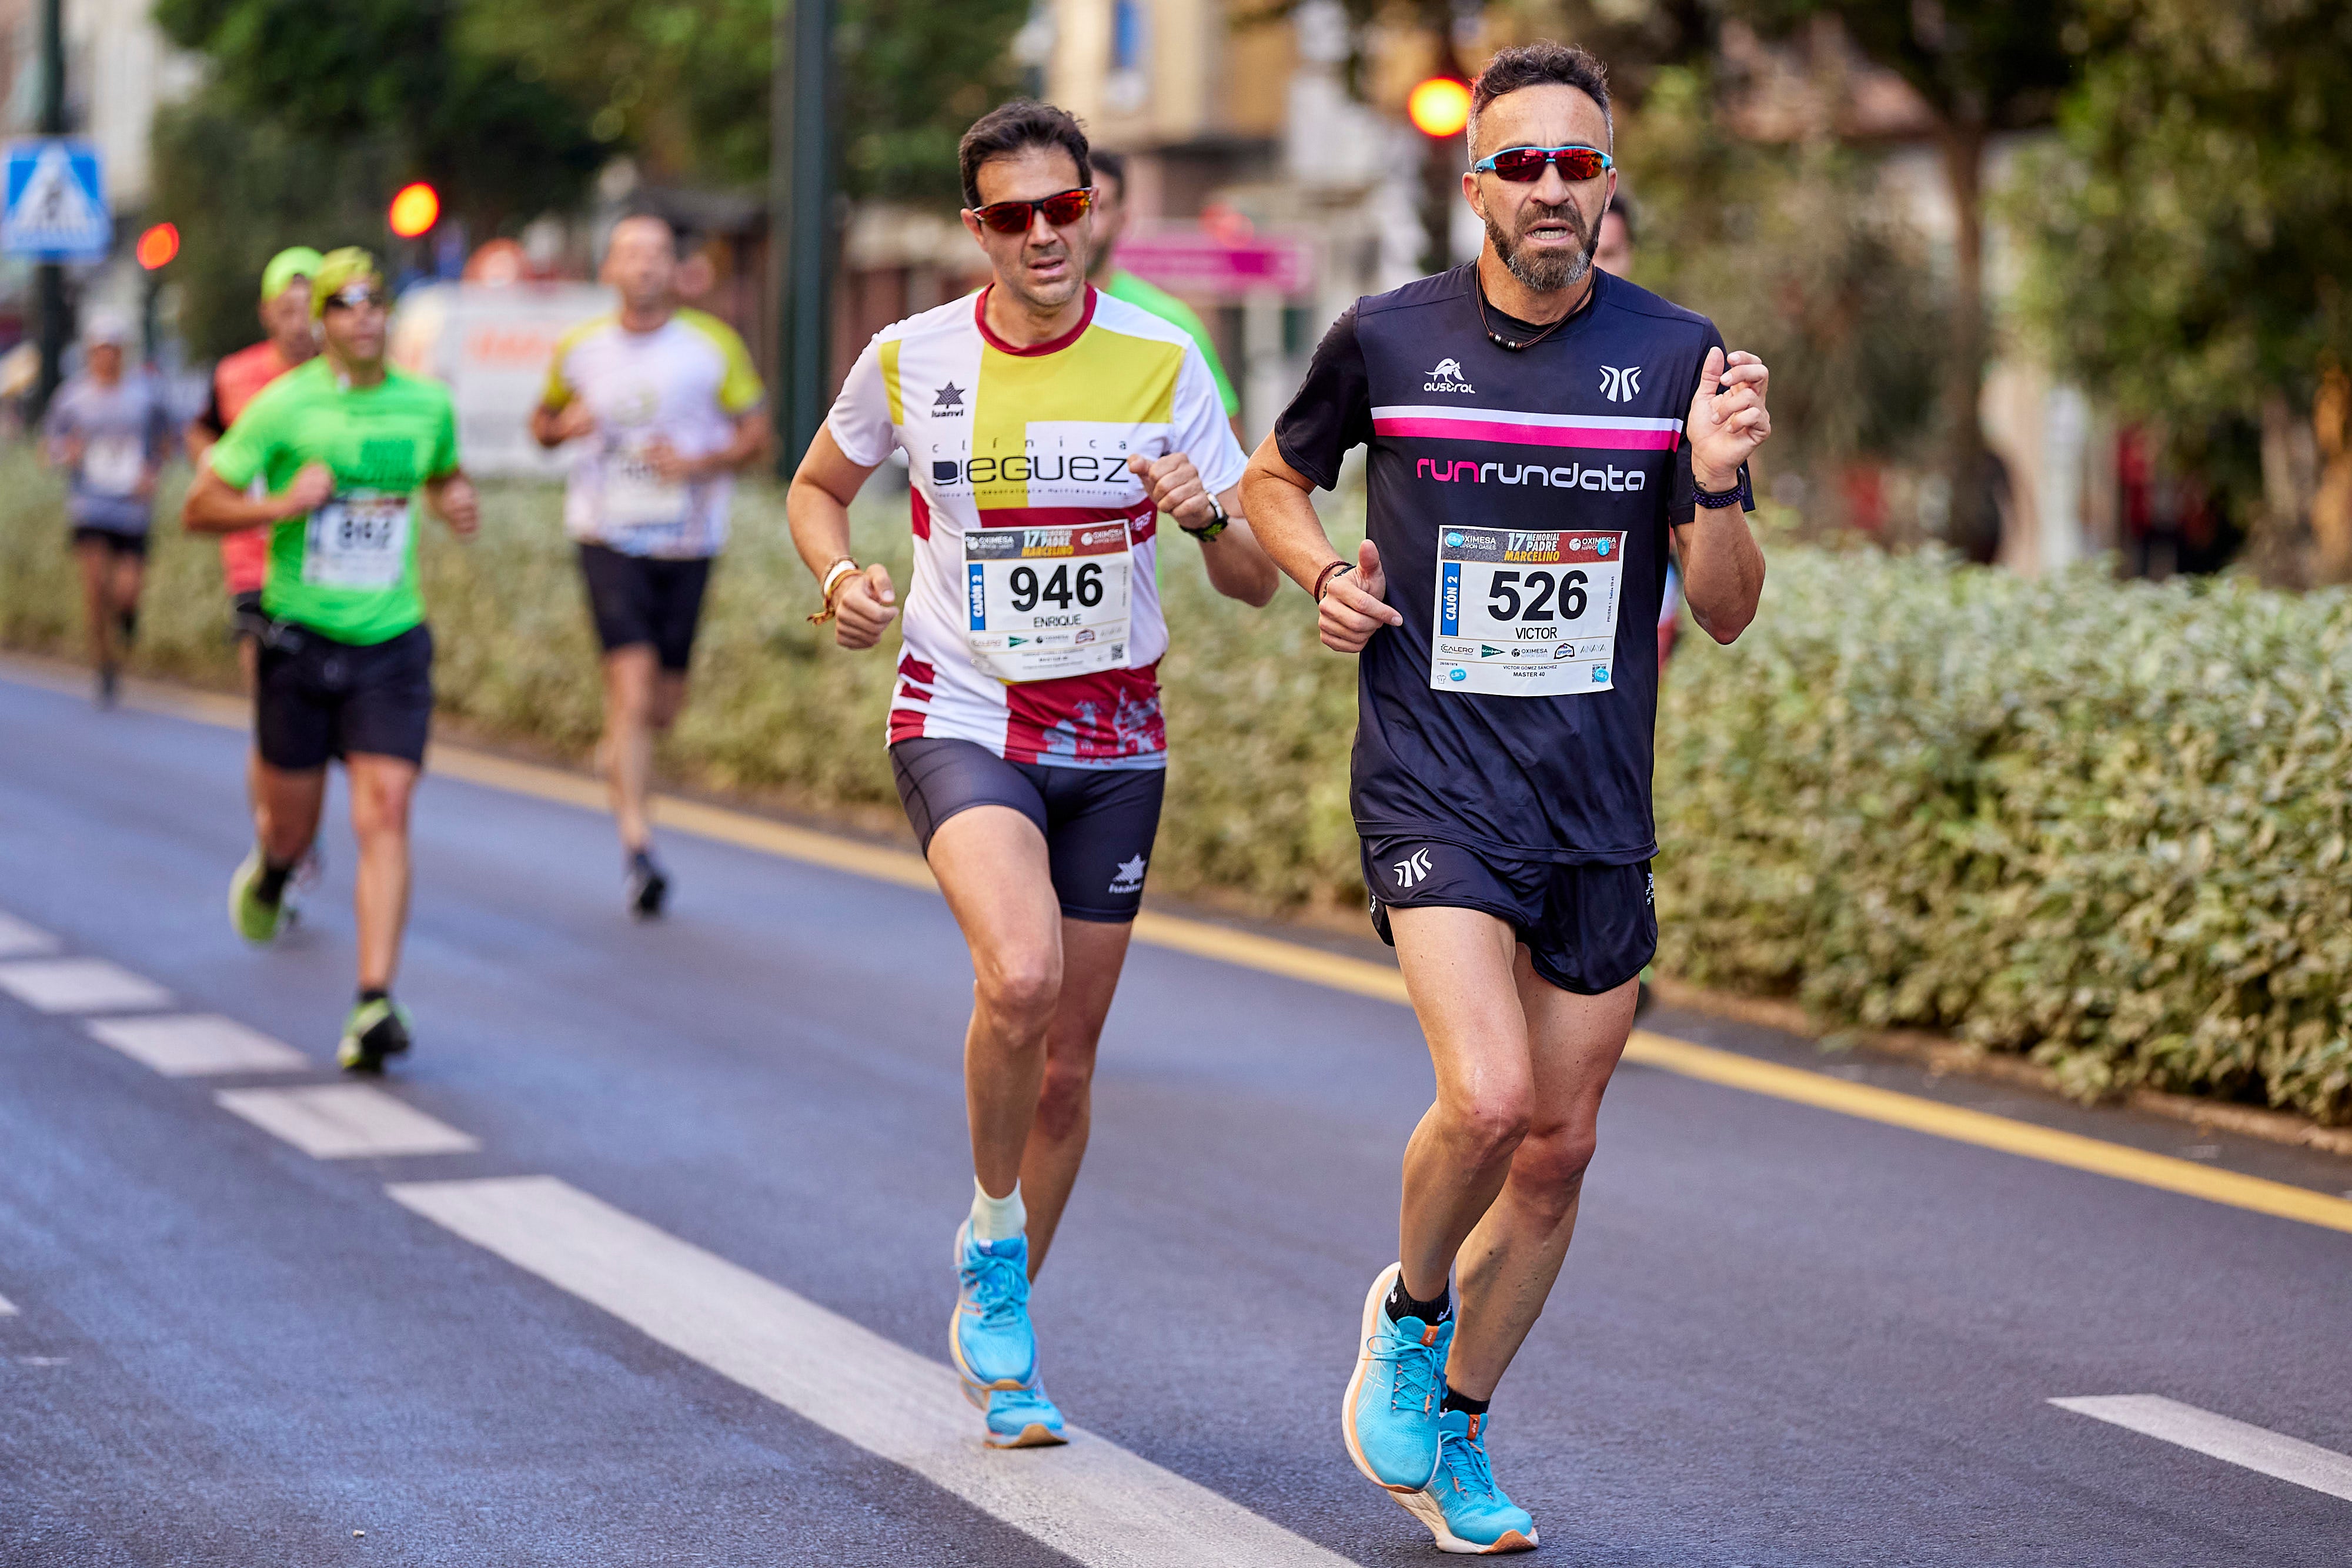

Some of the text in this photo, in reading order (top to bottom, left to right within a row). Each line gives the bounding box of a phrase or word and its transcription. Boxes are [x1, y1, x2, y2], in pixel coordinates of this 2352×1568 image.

[1424, 382, 1476, 394] austral
[1417, 459, 1645, 492] runrundata
[1462, 535, 1496, 544] XIMESA
[1507, 532, 1527, 551] 17
[1526, 533, 1559, 541] MEMORIAL
[1526, 540, 1558, 551] PADRE
[1504, 550, 1560, 561] MARCELINO
[1010, 563, 1103, 611] 946
[1488, 570, 1588, 621] 526
[1444, 587, 1457, 620] CAJÓN
[1033, 614, 1082, 628] ENRIQUE
[1515, 627, 1558, 640] VICTOR
